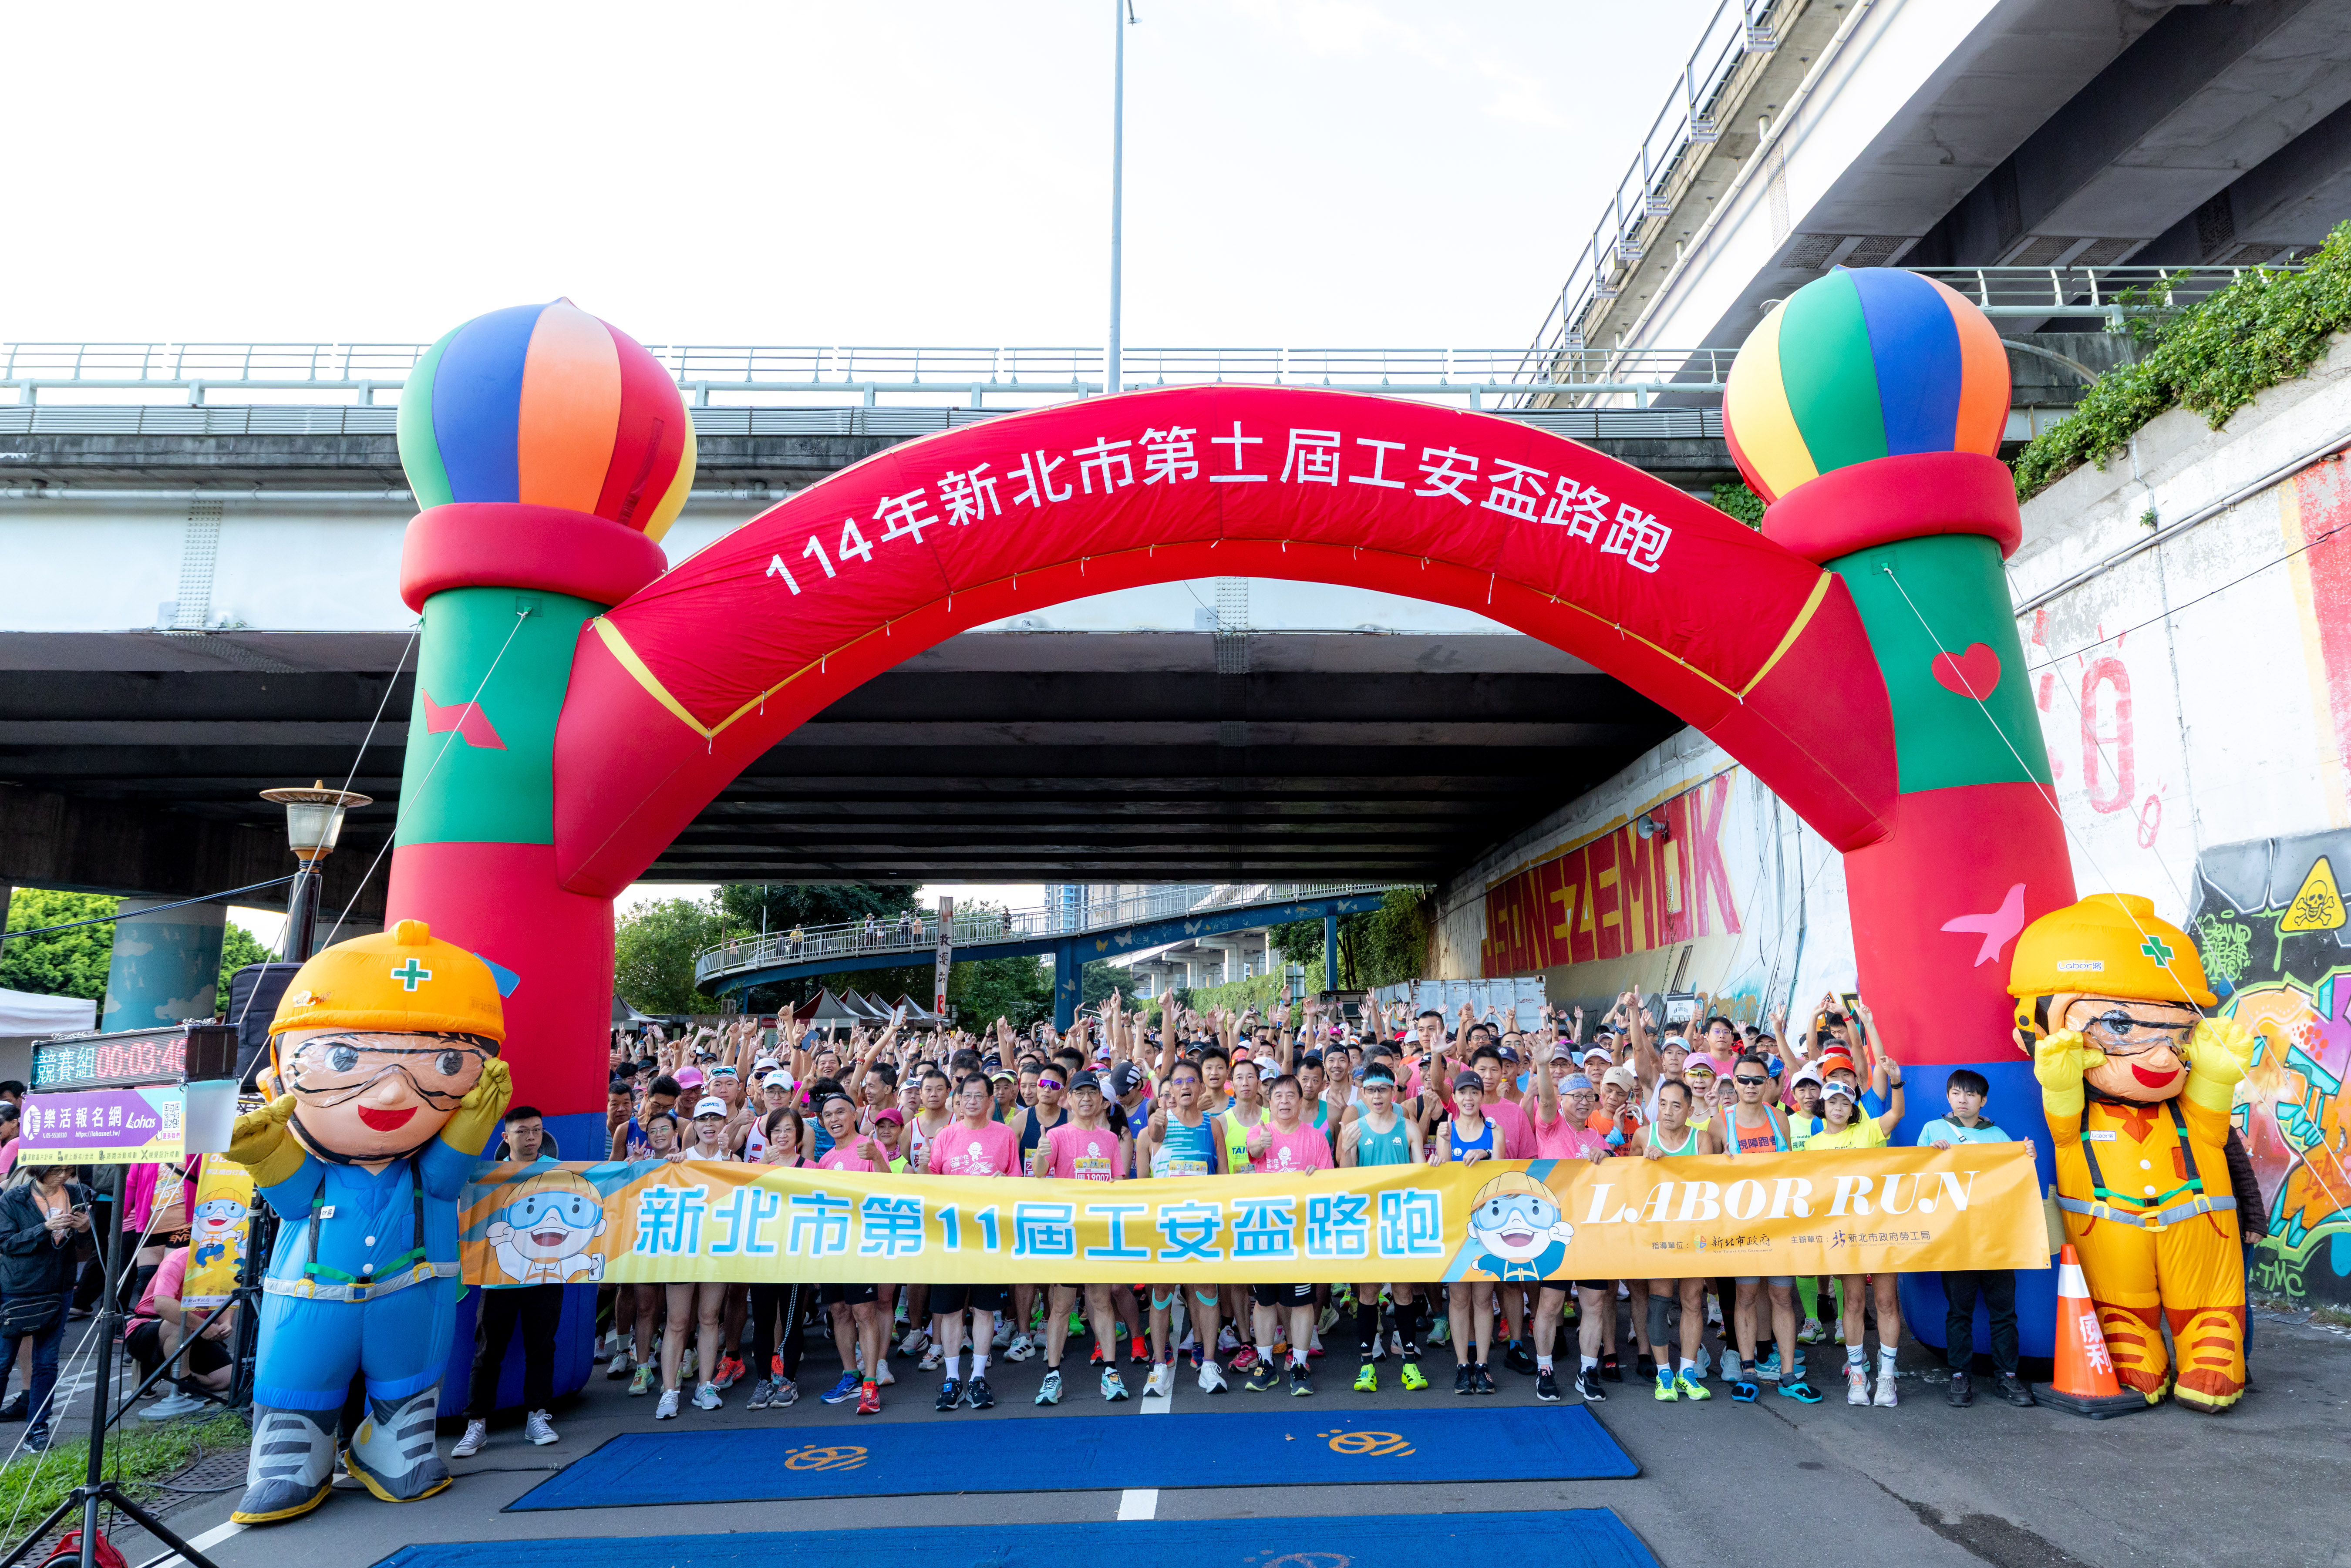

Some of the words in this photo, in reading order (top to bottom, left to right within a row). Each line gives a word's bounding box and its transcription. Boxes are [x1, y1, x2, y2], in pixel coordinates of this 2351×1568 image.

[44, 1106, 122, 1129] 樂活報名網
[125, 1112, 156, 1129] Lohas
[1581, 1177, 1814, 1224] LABOR
[1830, 1171, 1979, 1216] RUN
[633, 1184, 1445, 1262] 新北市第11屆工安盃路跑
[1711, 1235, 1770, 1248] 新北市政府
[1848, 1231, 1930, 1243] 新北市政府勞工局
